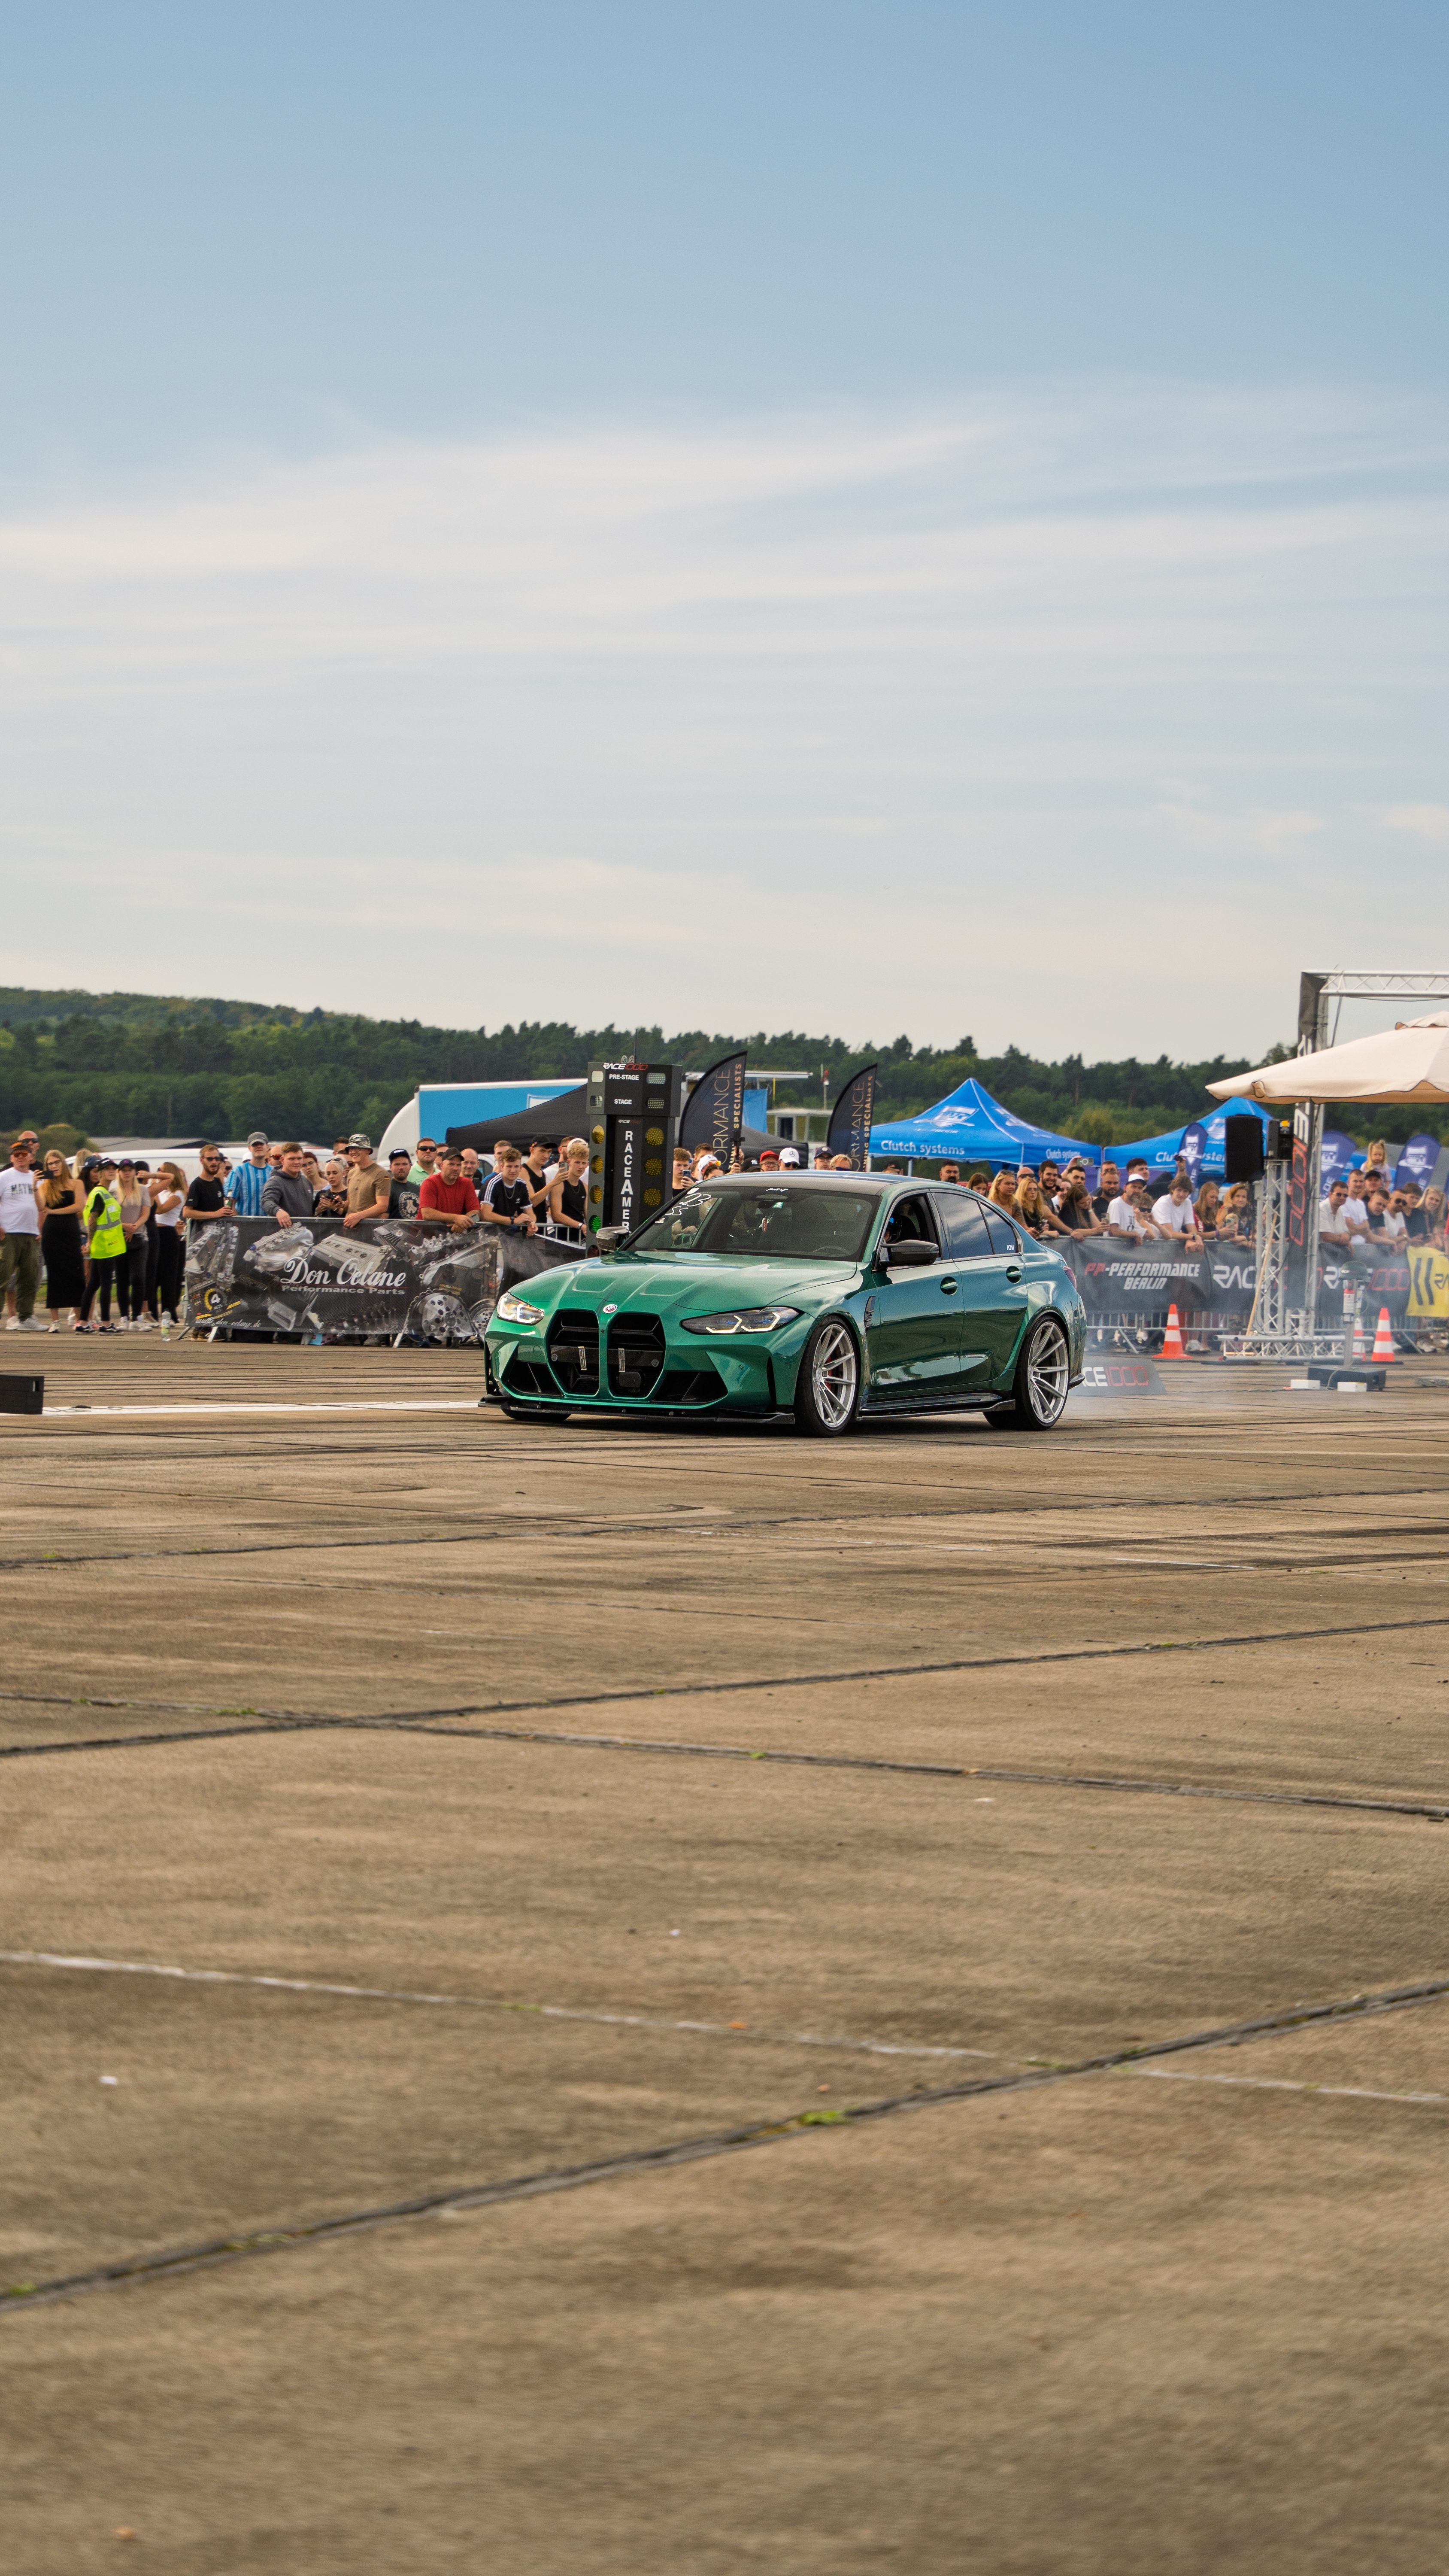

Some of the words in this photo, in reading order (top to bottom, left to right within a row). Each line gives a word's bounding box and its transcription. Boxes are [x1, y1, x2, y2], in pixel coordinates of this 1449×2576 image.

[734, 1063, 742, 1129] SPECIALISTS
[864, 1075, 873, 1137] SPECIALISTS
[881, 1140, 916, 1152] Clutch
[920, 1144, 965, 1156] systems
[1046, 1148, 1061, 1159] Clutch
[679, 1193, 712, 1207] 23
[280, 1257, 331, 1284] Don
[336, 1258, 406, 1287] Octane
[1085, 1263, 1200, 1277] PP-PERFORMANCE
[282, 1285, 365, 1294] Performance
[369, 1287, 406, 1295] Parts
[1123, 1277, 1167, 1290] BERLIN
[211, 1293, 221, 1304] 4
